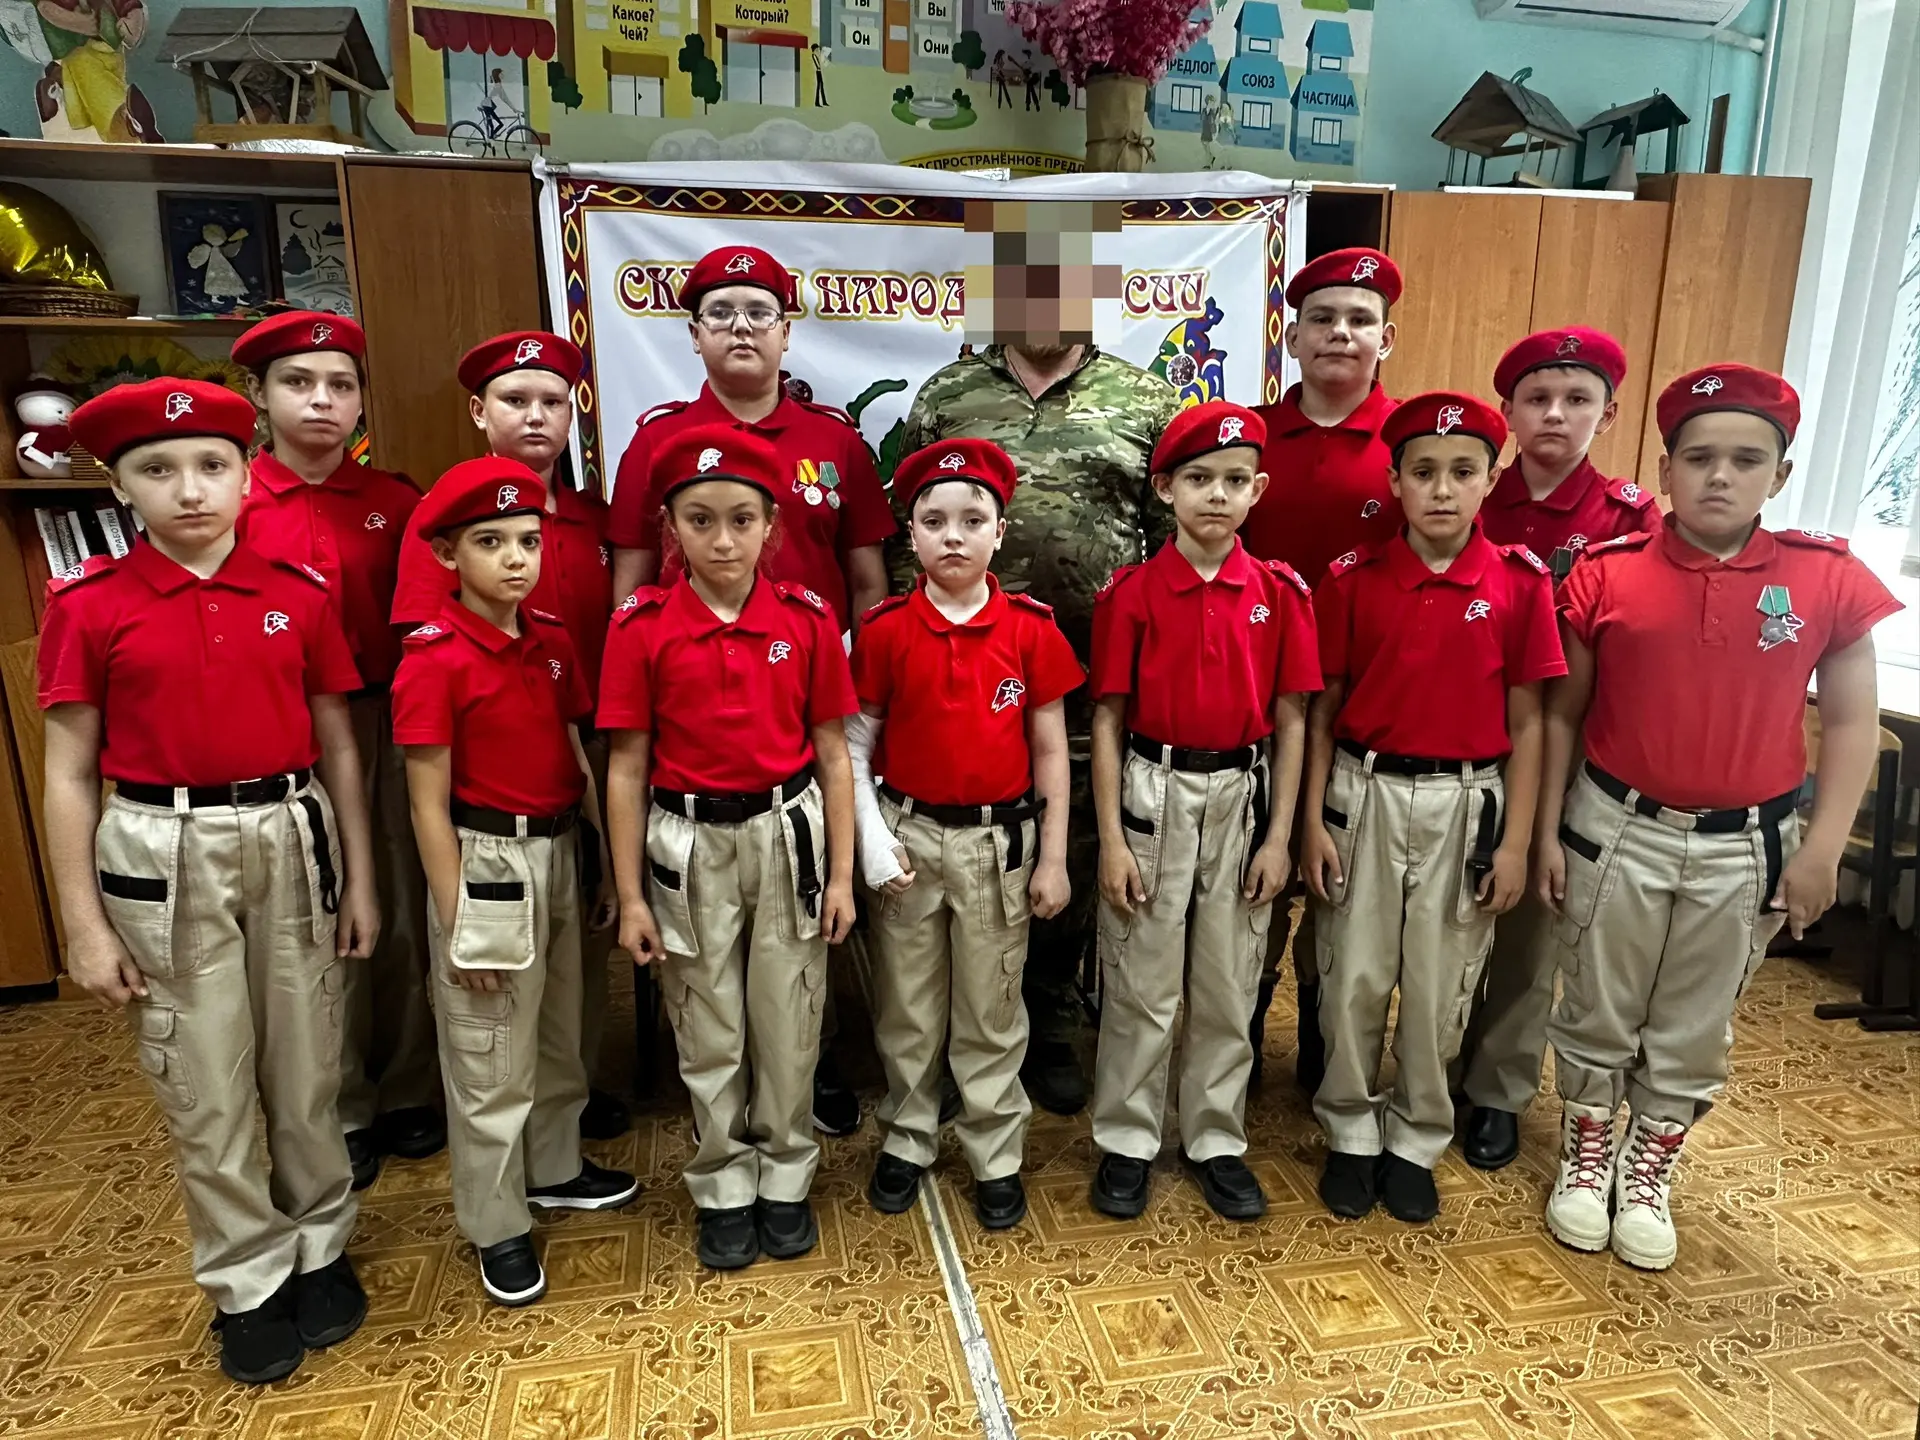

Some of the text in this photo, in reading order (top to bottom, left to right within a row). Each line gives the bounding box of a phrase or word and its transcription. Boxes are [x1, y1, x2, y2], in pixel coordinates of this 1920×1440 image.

[612, 4, 655, 23] Какое?
[734, 4, 789, 25] Который?
[927, 2, 946, 17] Вы
[619, 24, 649, 42] Чей?
[852, 30, 870, 46] Он
[923, 39, 949, 55] Они
[1241, 73, 1275, 89] СОЮЗ
[1302, 90, 1355, 109] ЧАСТИЦА
[909, 152, 1041, 170] АСПРОСТРАНЁННОЕ
[815, 274, 965, 326] НАРОД
